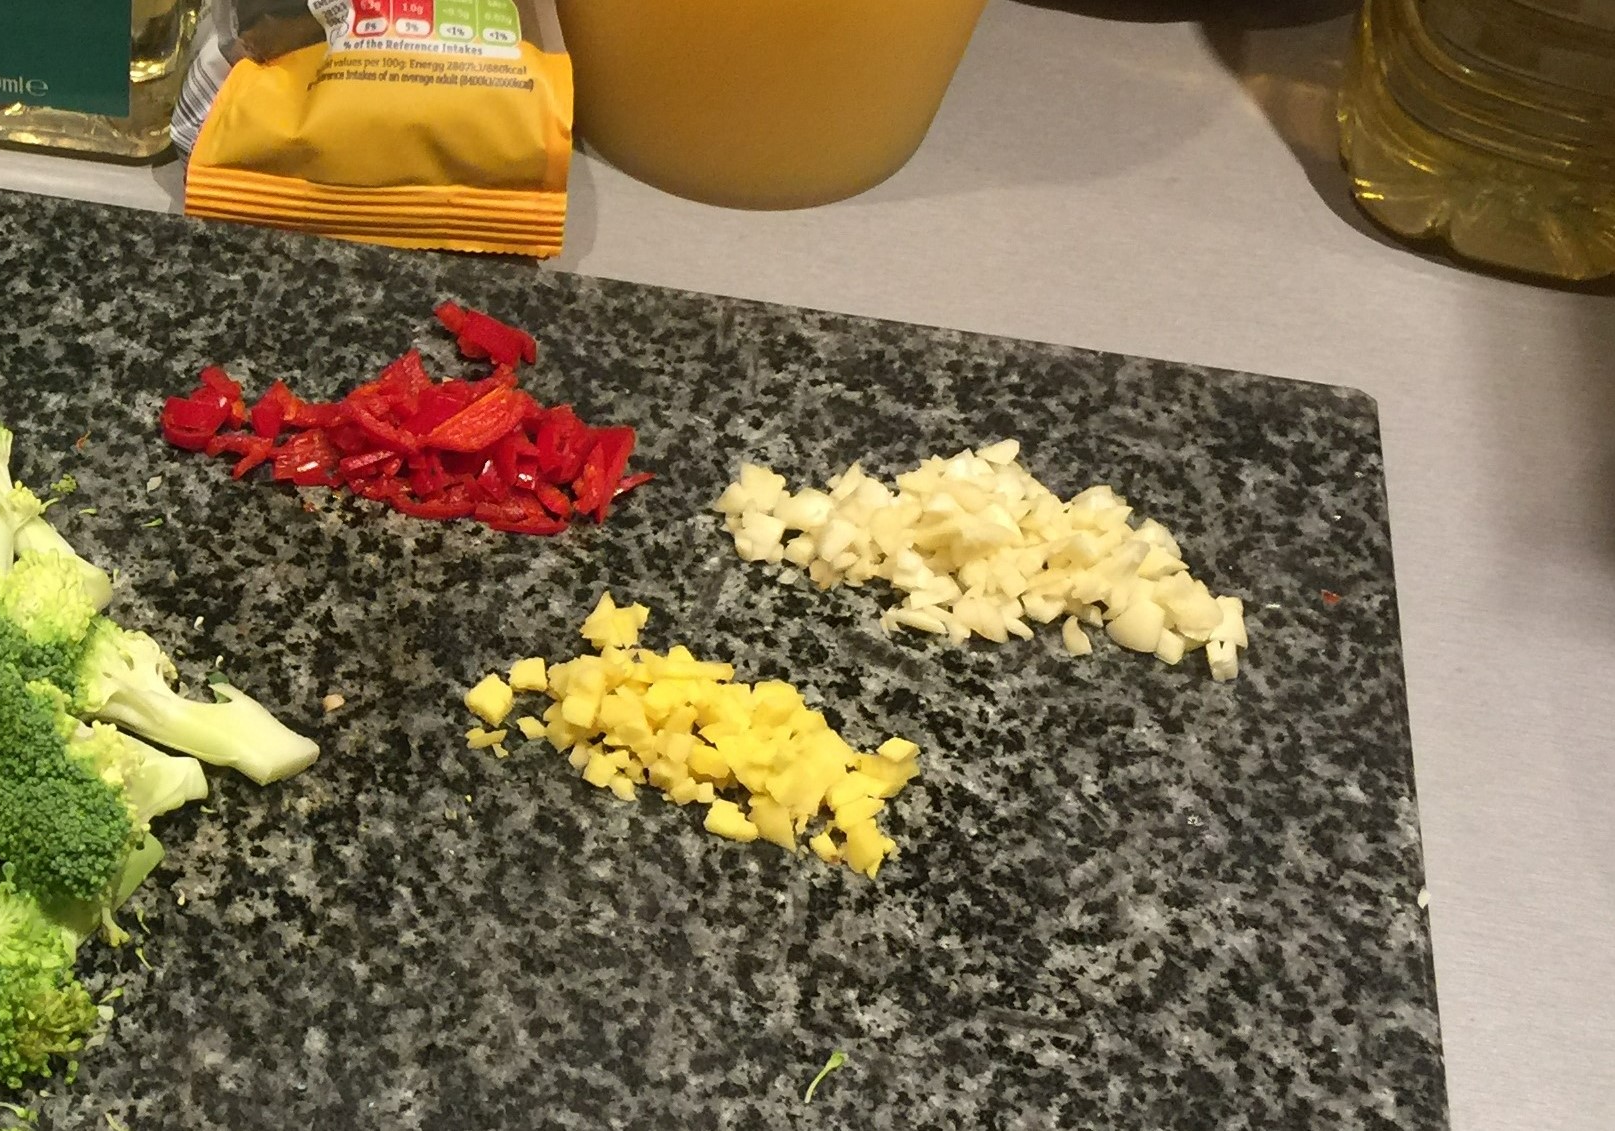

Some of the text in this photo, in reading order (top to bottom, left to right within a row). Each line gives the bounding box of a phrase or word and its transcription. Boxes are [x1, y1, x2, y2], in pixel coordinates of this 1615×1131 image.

[354, 40, 364, 49] of
[366, 39, 383, 48] the
[386, 40, 440, 52] Reference
[442, 43, 483, 55] Intakes
[333, 57, 361, 67] values
[364, 59, 379, 69] per
[409, 59, 445, 73] Energy
[378, 70, 388, 81] of
